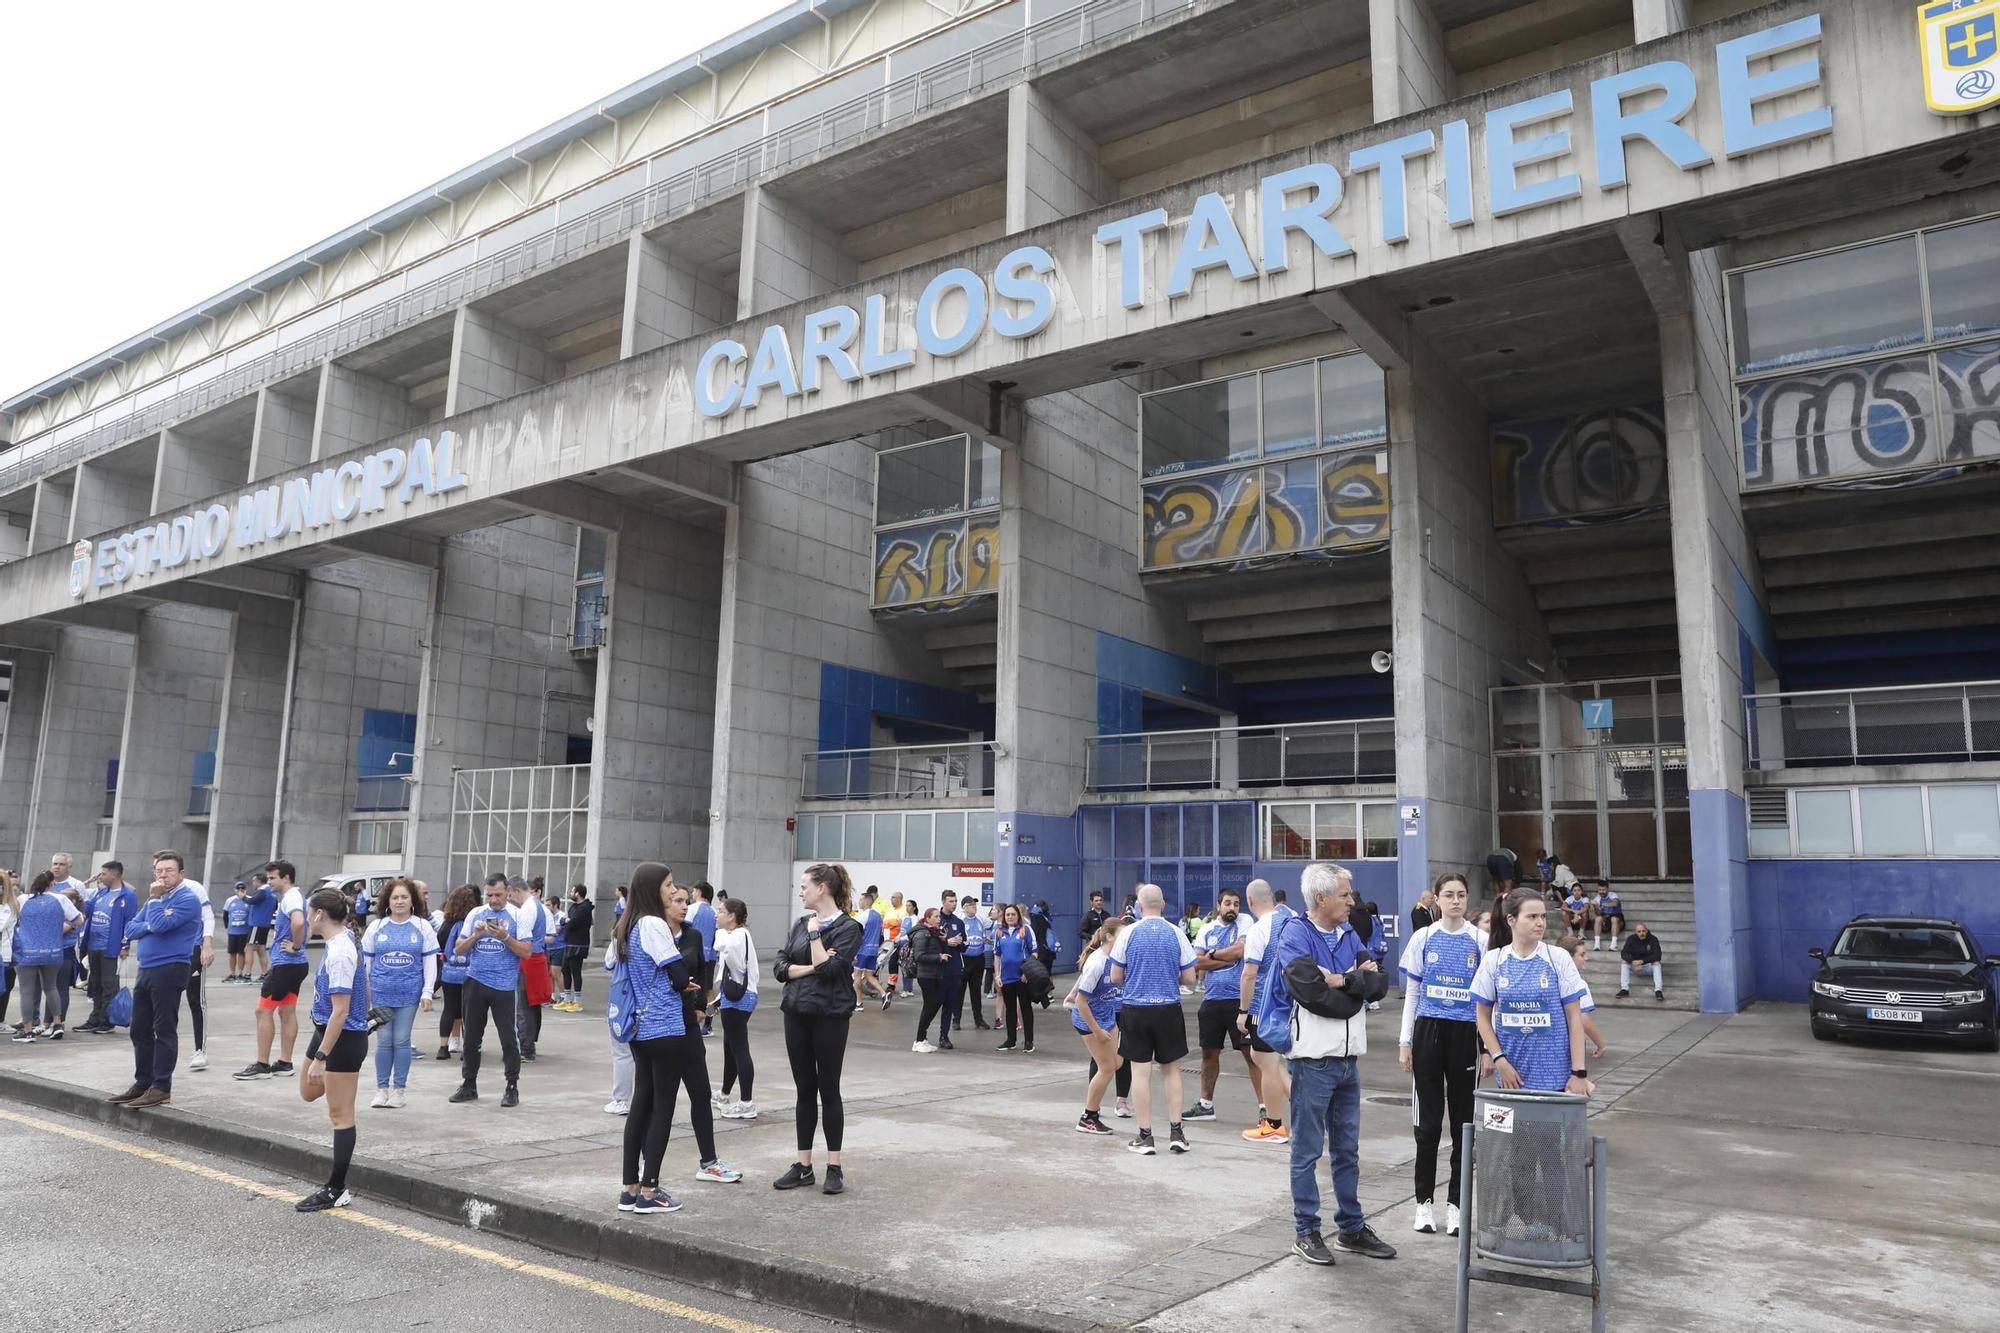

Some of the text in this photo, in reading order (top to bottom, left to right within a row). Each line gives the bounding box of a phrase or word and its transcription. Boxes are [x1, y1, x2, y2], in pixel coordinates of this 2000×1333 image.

[95, 13, 1833, 587] ESTADIO MUNICIPAL CARLOS TARTIERE
[1591, 702, 1604, 725] 7
[1016, 855, 1041, 864] OFICINAS
[1436, 975, 1464, 984] MARCHA
[1446, 990, 1468, 999] 1809
[1509, 1001, 1541, 1009] MARCHA
[1874, 1010, 1920, 1020] 6508 KDF
[1523, 1016, 1547, 1025] 1204
